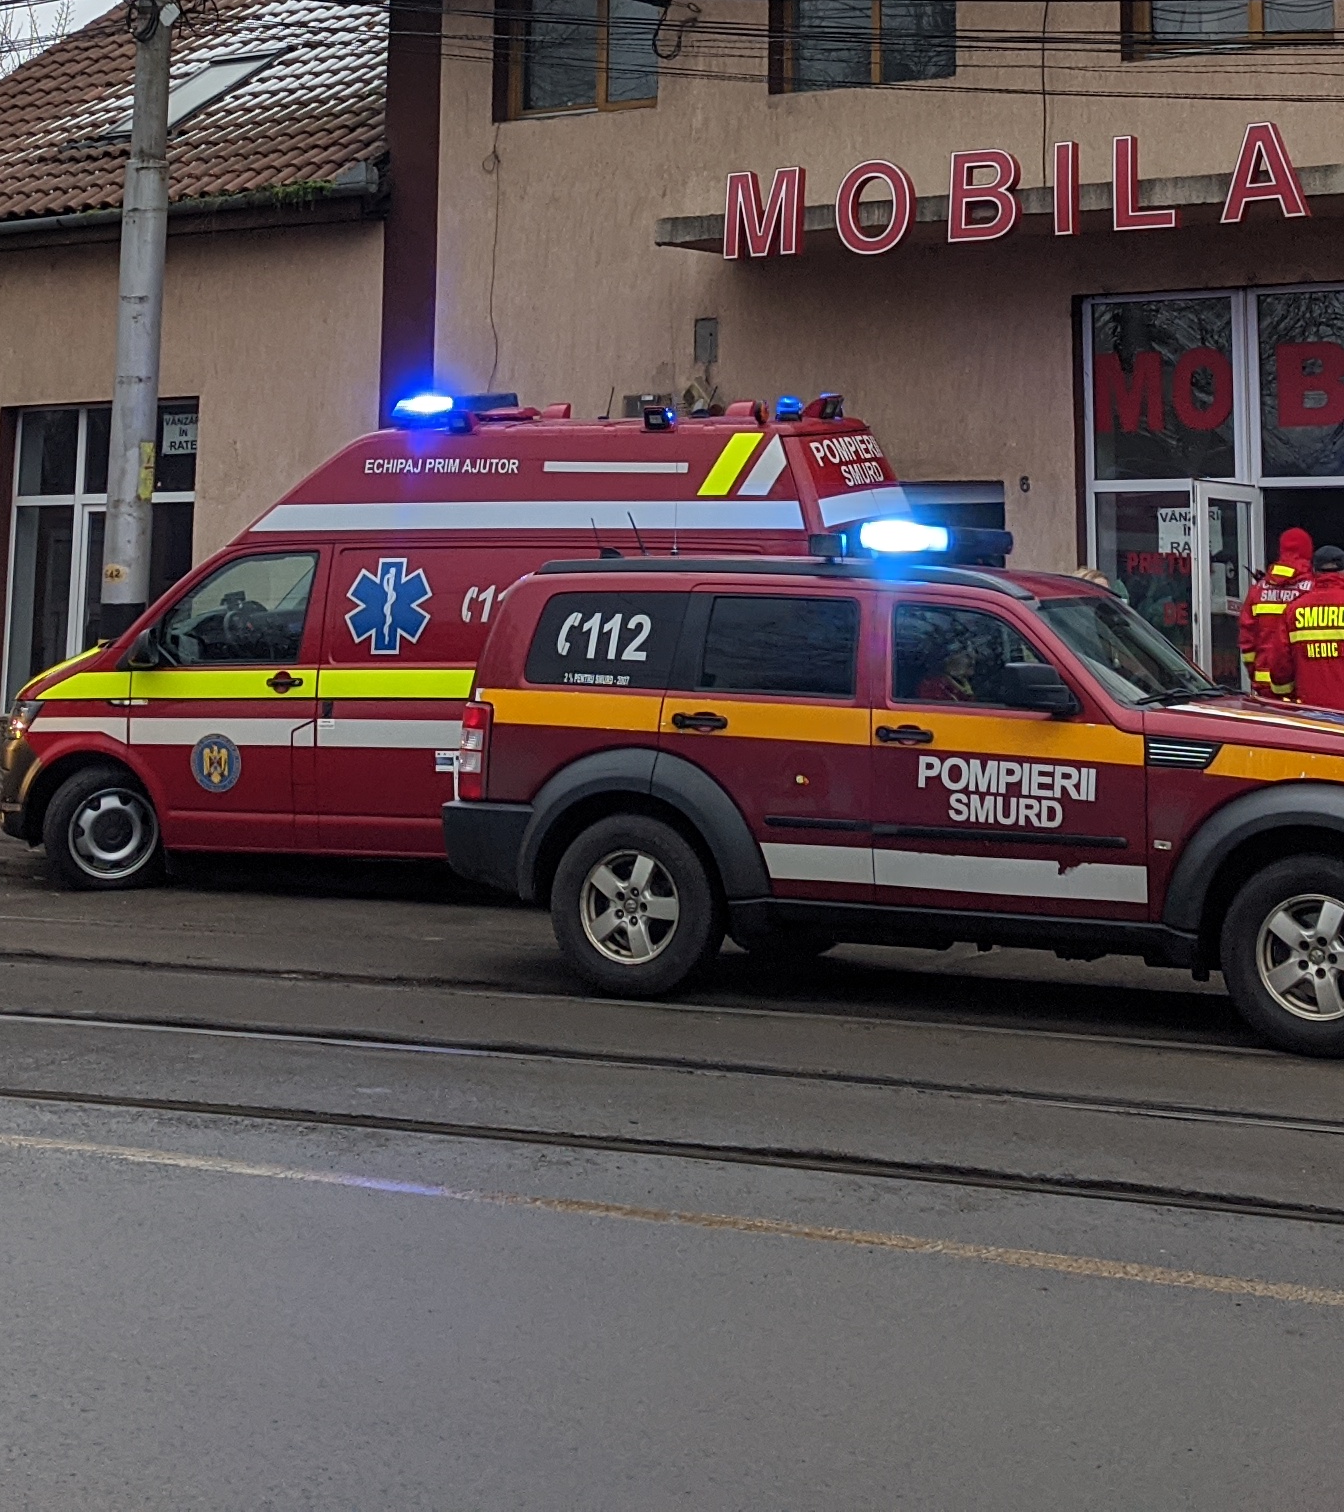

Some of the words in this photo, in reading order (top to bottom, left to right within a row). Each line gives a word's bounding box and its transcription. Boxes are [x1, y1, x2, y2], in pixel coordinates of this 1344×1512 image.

[723, 120, 1312, 260] MOBILA
[169, 440, 197, 451] RATE
[364, 459, 422, 473] ECHIPAJ
[425, 459, 459, 473] PRIM
[462, 459, 519, 473] AJUTOR
[841, 461, 884, 487] SMURD
[1020, 476, 1031, 493] 6
[1307, 643, 1339, 658] MEDIC
[918, 755, 1097, 802] POMPIERII
[948, 793, 1063, 828] SMURD
